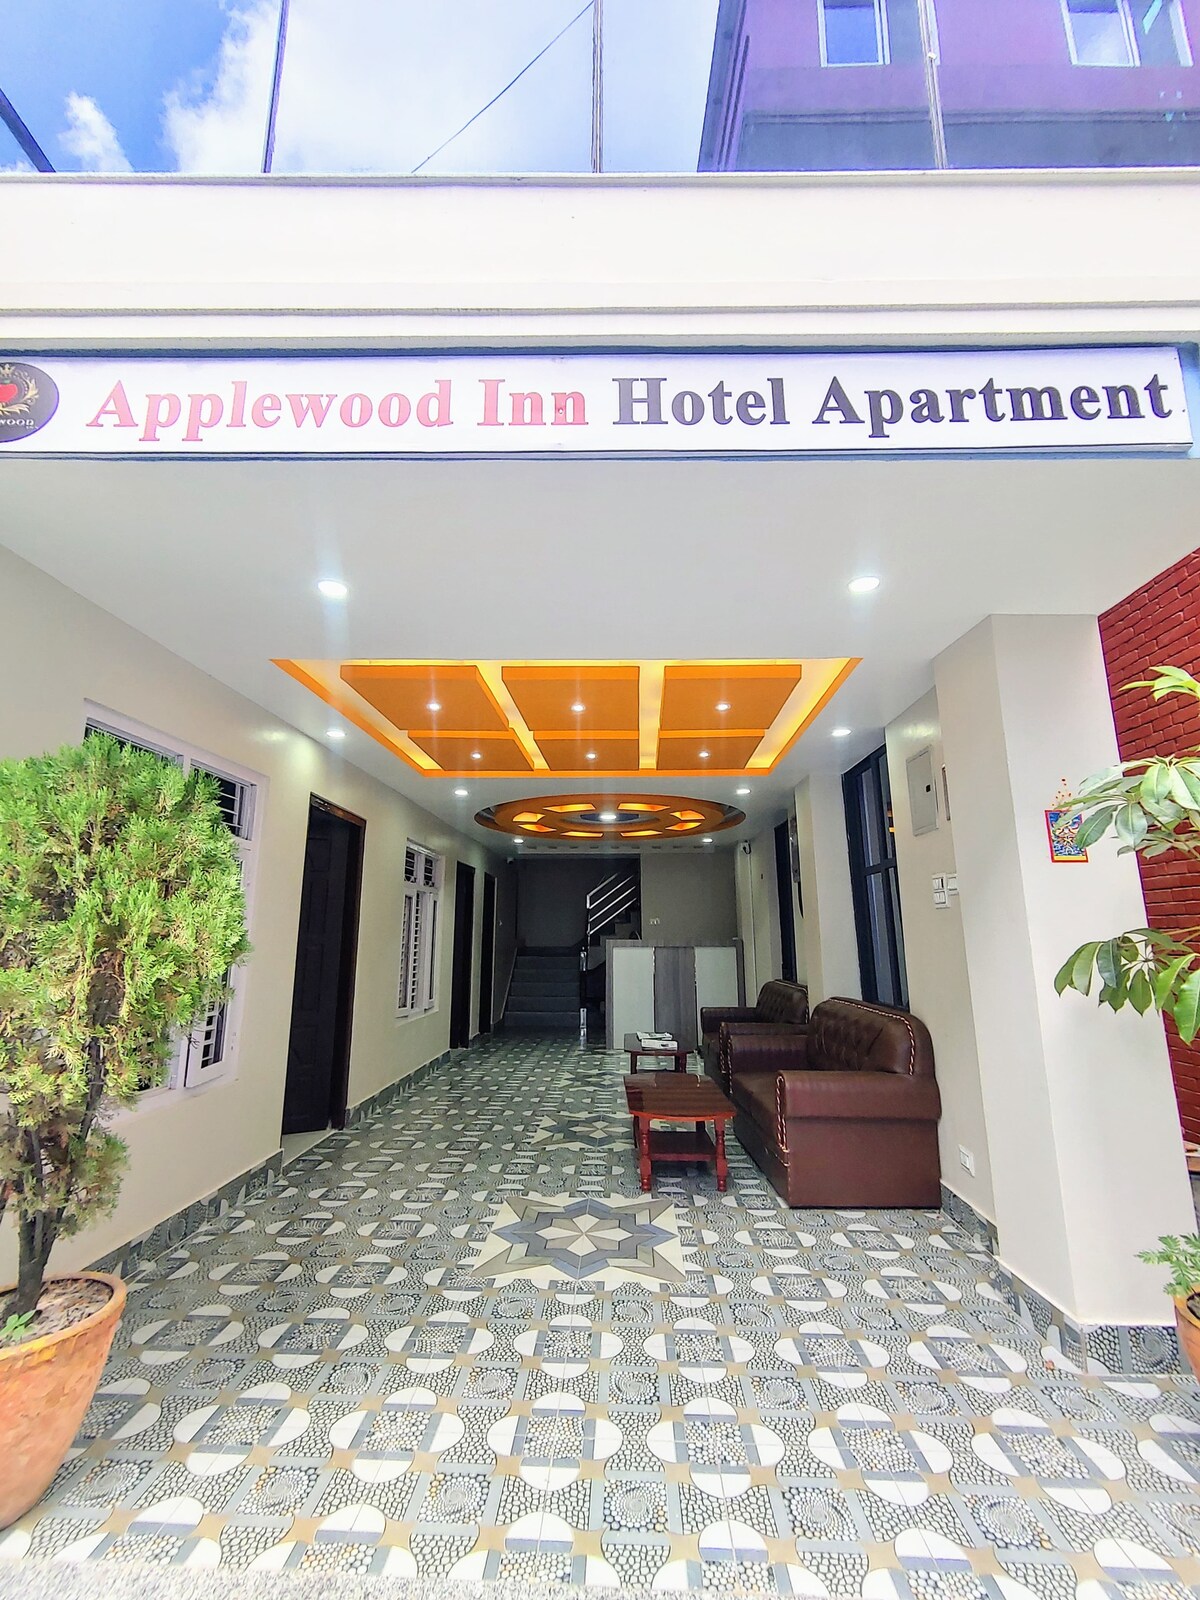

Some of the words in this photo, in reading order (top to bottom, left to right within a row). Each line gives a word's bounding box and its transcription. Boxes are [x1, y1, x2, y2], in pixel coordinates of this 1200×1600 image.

[85, 379, 454, 443] Applewood
[476, 378, 590, 427] Inn
[611, 376, 791, 426] Hotel
[811, 372, 1174, 439] Apartment
